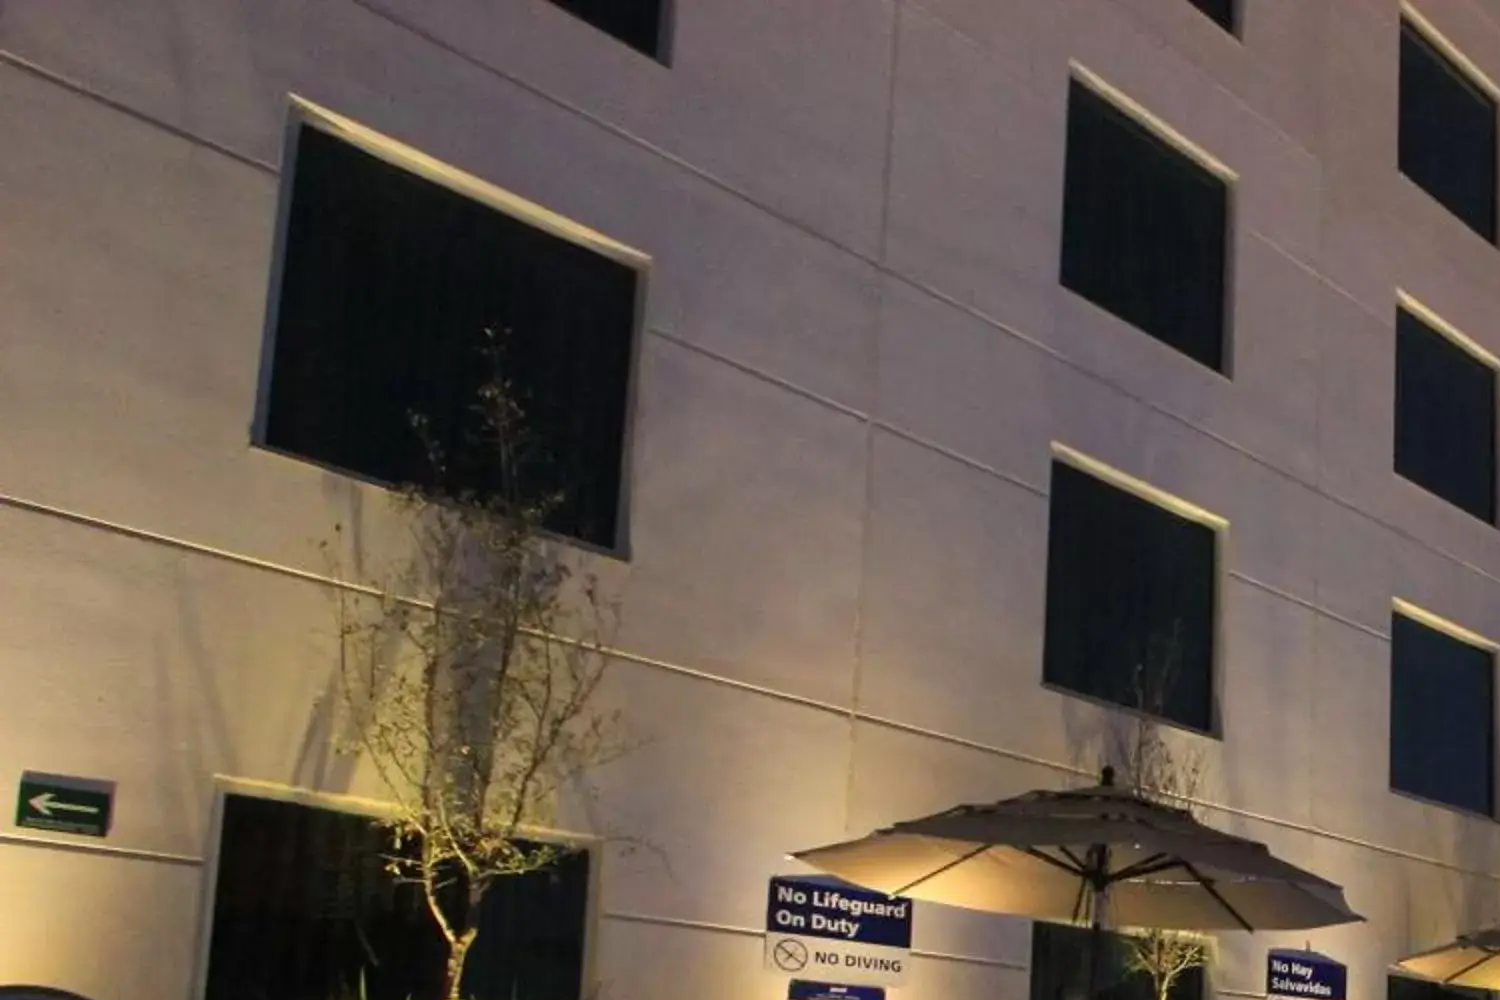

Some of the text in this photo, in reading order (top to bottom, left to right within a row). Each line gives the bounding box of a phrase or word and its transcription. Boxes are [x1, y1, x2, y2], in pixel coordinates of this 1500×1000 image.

[777, 886, 906, 919] No Lifeguard
[776, 909, 860, 939] On Duty
[815, 951, 902, 973] NO DIVING
[1272, 960, 1289, 974] No
